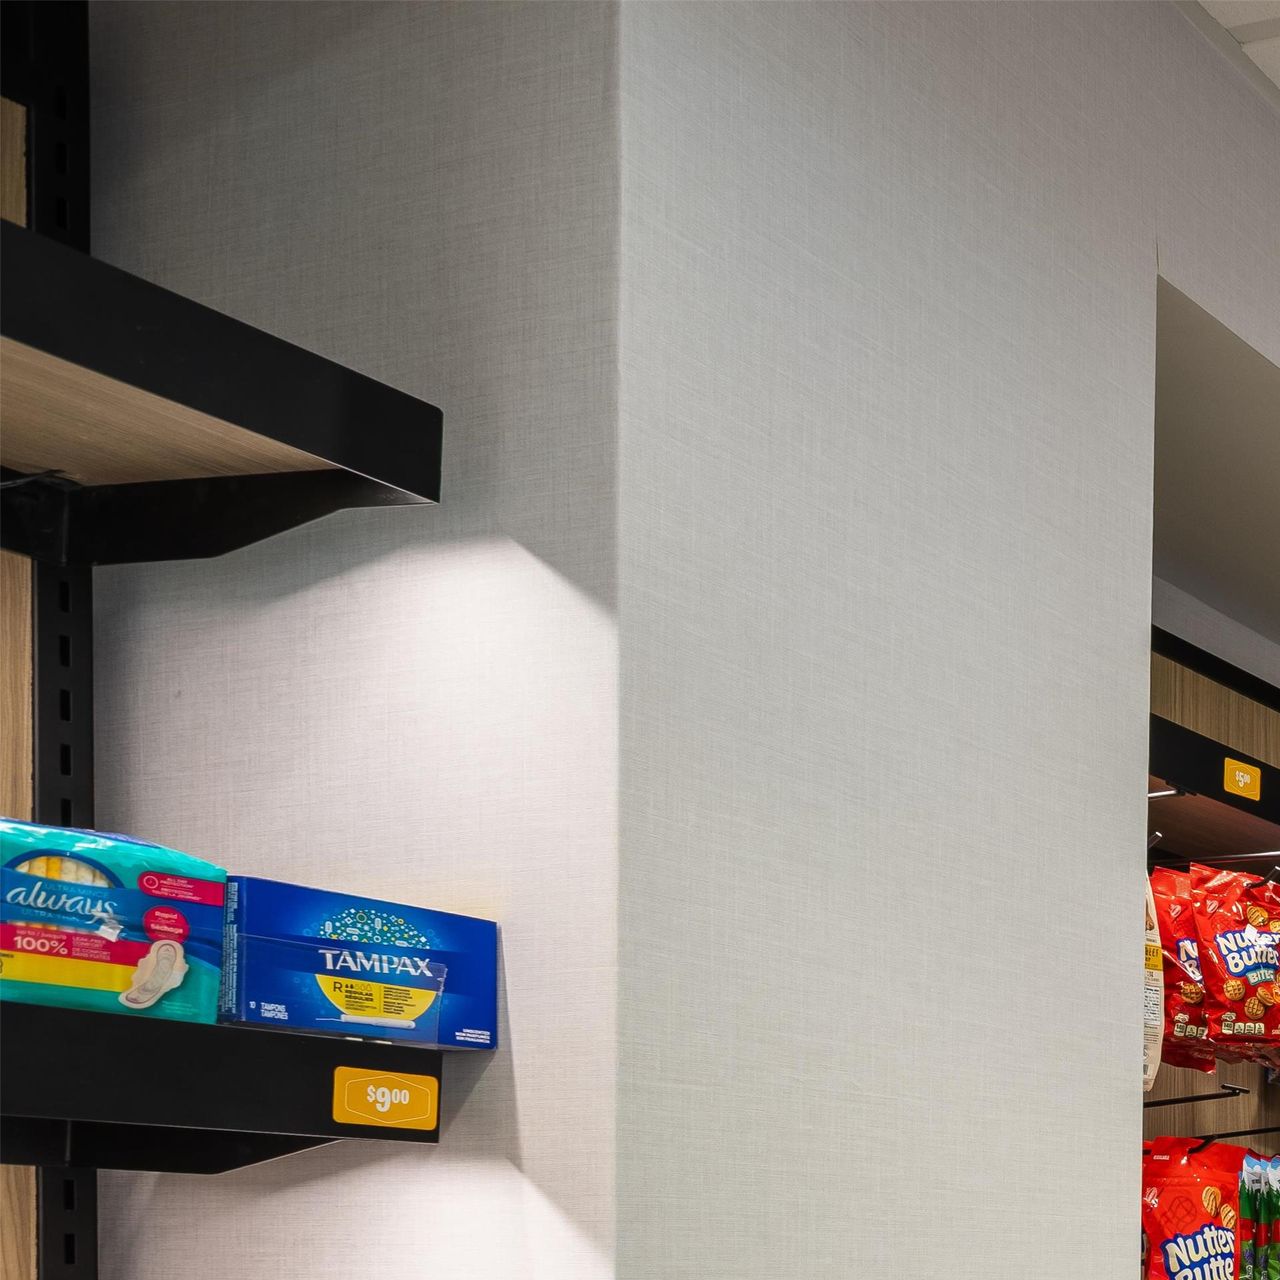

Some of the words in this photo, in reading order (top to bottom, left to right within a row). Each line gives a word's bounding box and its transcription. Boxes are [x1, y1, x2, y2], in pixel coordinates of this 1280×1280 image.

[6, 881, 118, 924] always
[14, 936, 68, 955] 100%
[318, 949, 433, 977] TAMPAX
[333, 981, 343, 993] R
